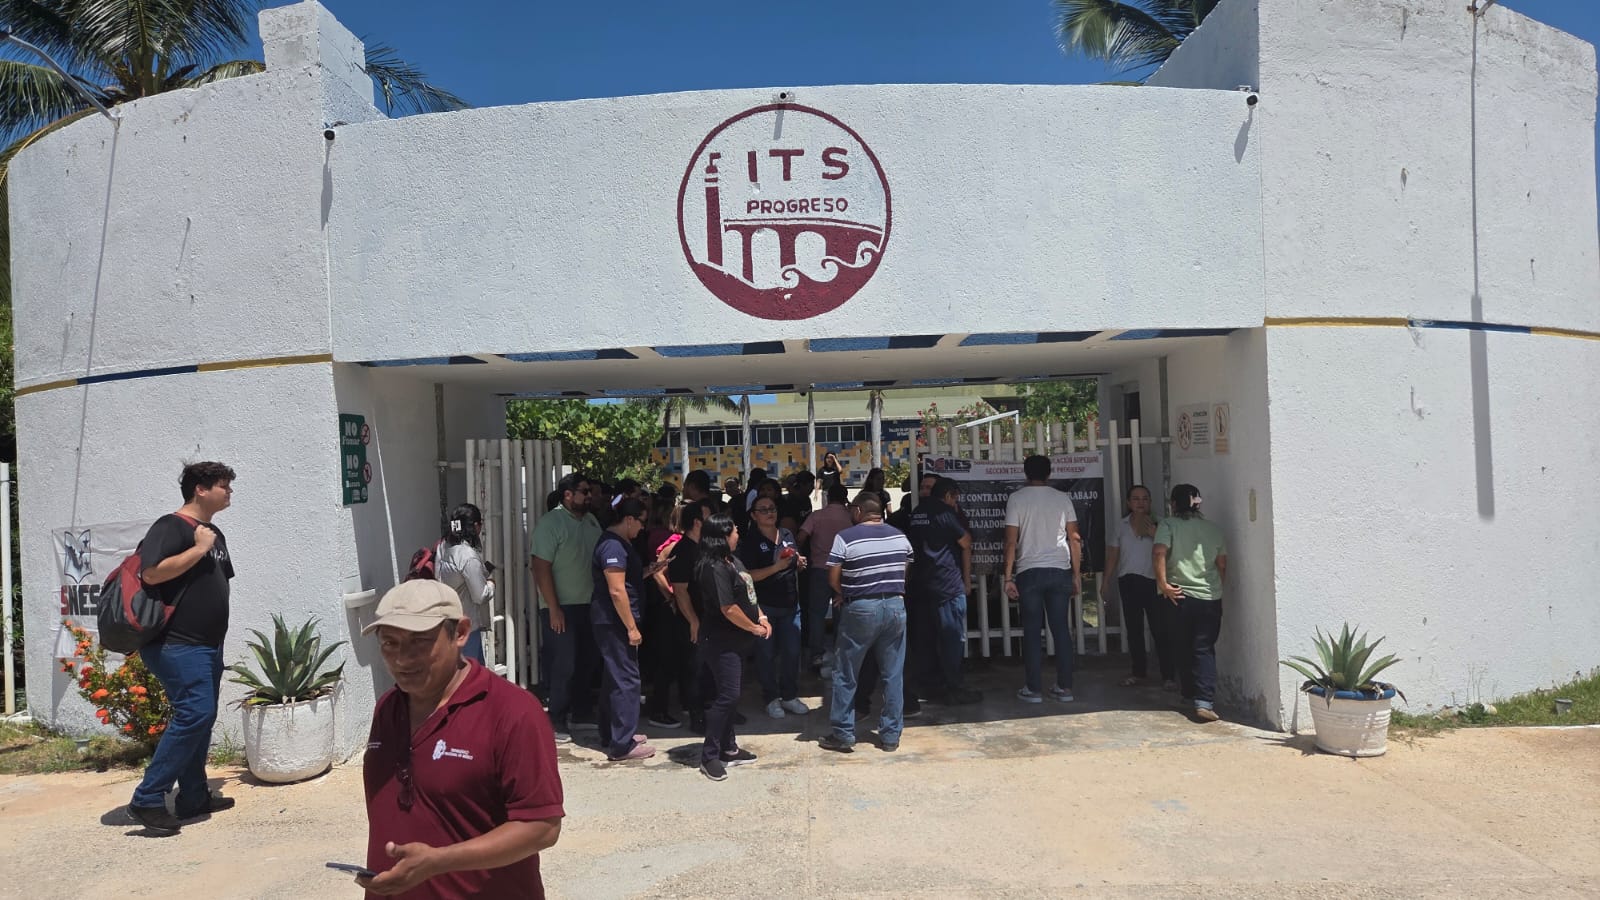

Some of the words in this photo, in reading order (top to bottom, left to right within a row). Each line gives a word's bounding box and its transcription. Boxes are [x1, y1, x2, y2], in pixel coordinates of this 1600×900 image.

[748, 147, 850, 182] ITS
[746, 197, 849, 214] PROGRESO
[345, 421, 358, 437] NO
[346, 454, 359, 470] NO
[966, 493, 1009, 502] CONTRATO
[962, 508, 1006, 518] STABILIDA
